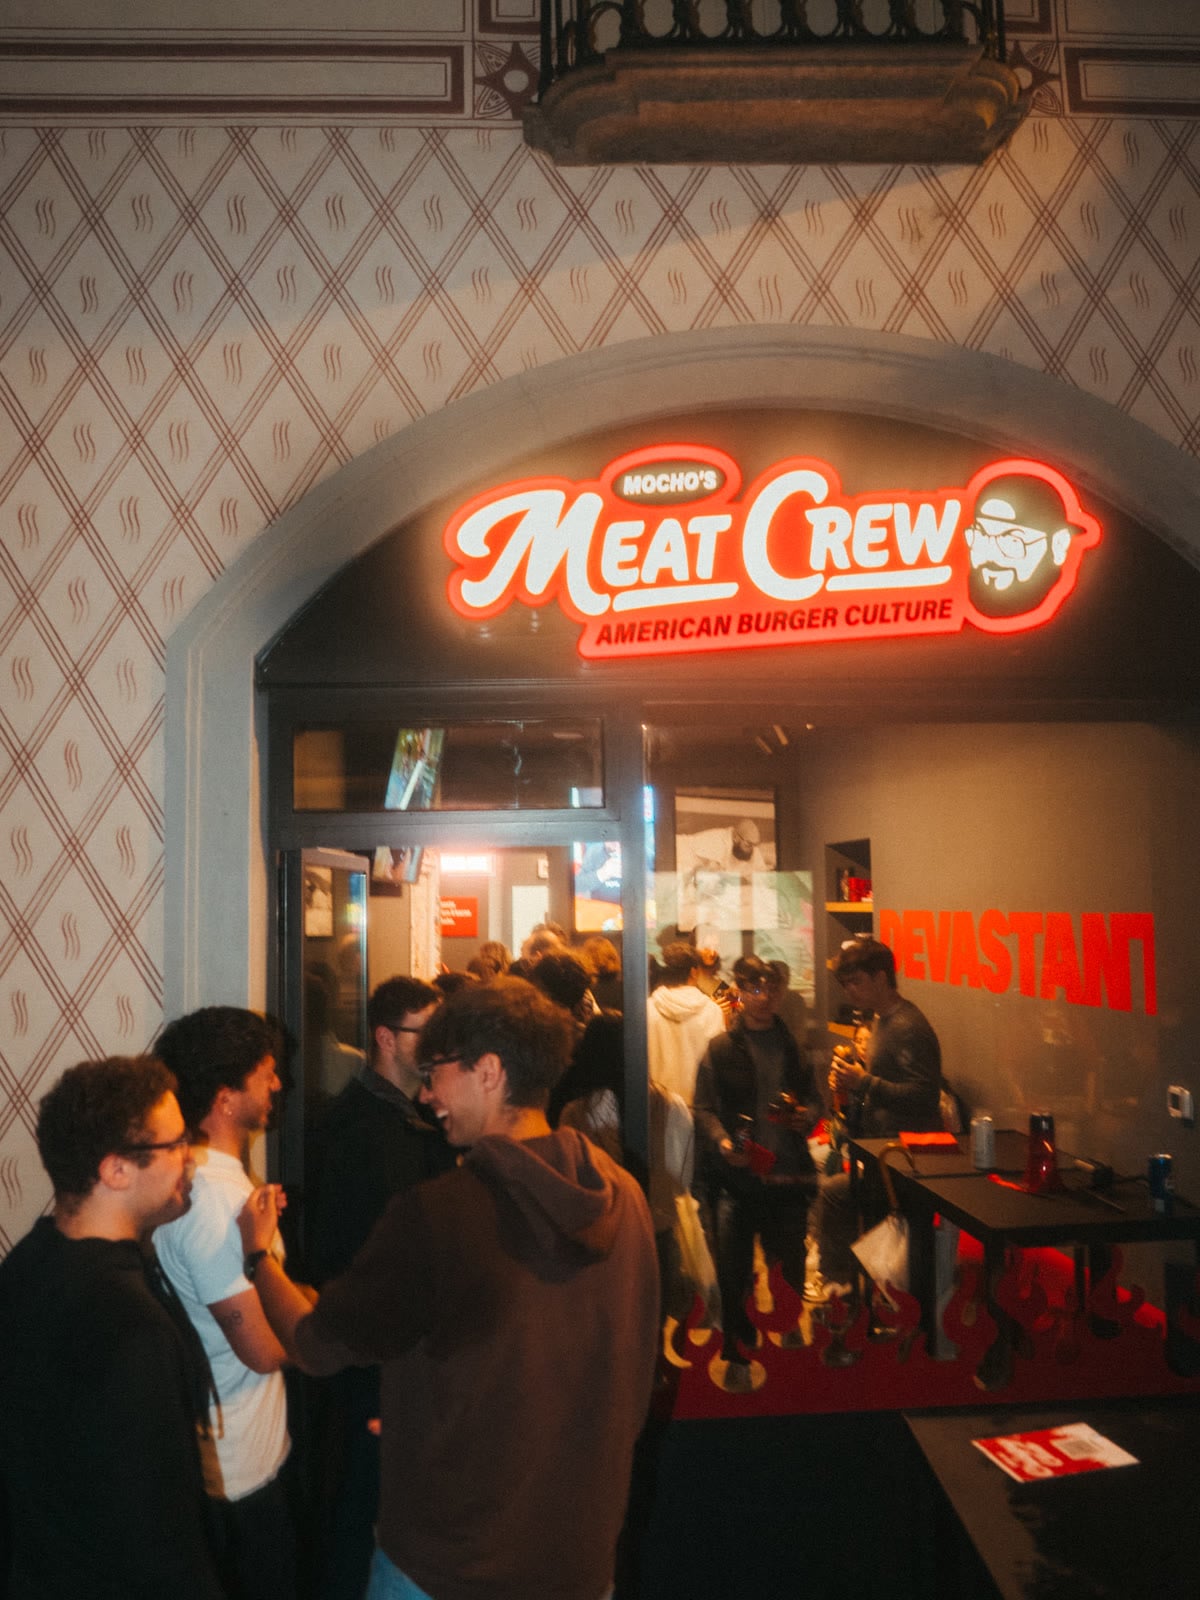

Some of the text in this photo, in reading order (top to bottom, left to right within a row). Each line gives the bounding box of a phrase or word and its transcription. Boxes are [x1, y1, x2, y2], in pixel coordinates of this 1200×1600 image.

[623, 469, 718, 497] MOCHO'S
[456, 469, 962, 616] MEAT CREW
[595, 598, 954, 646] AMERICAN BURGER CULTURE
